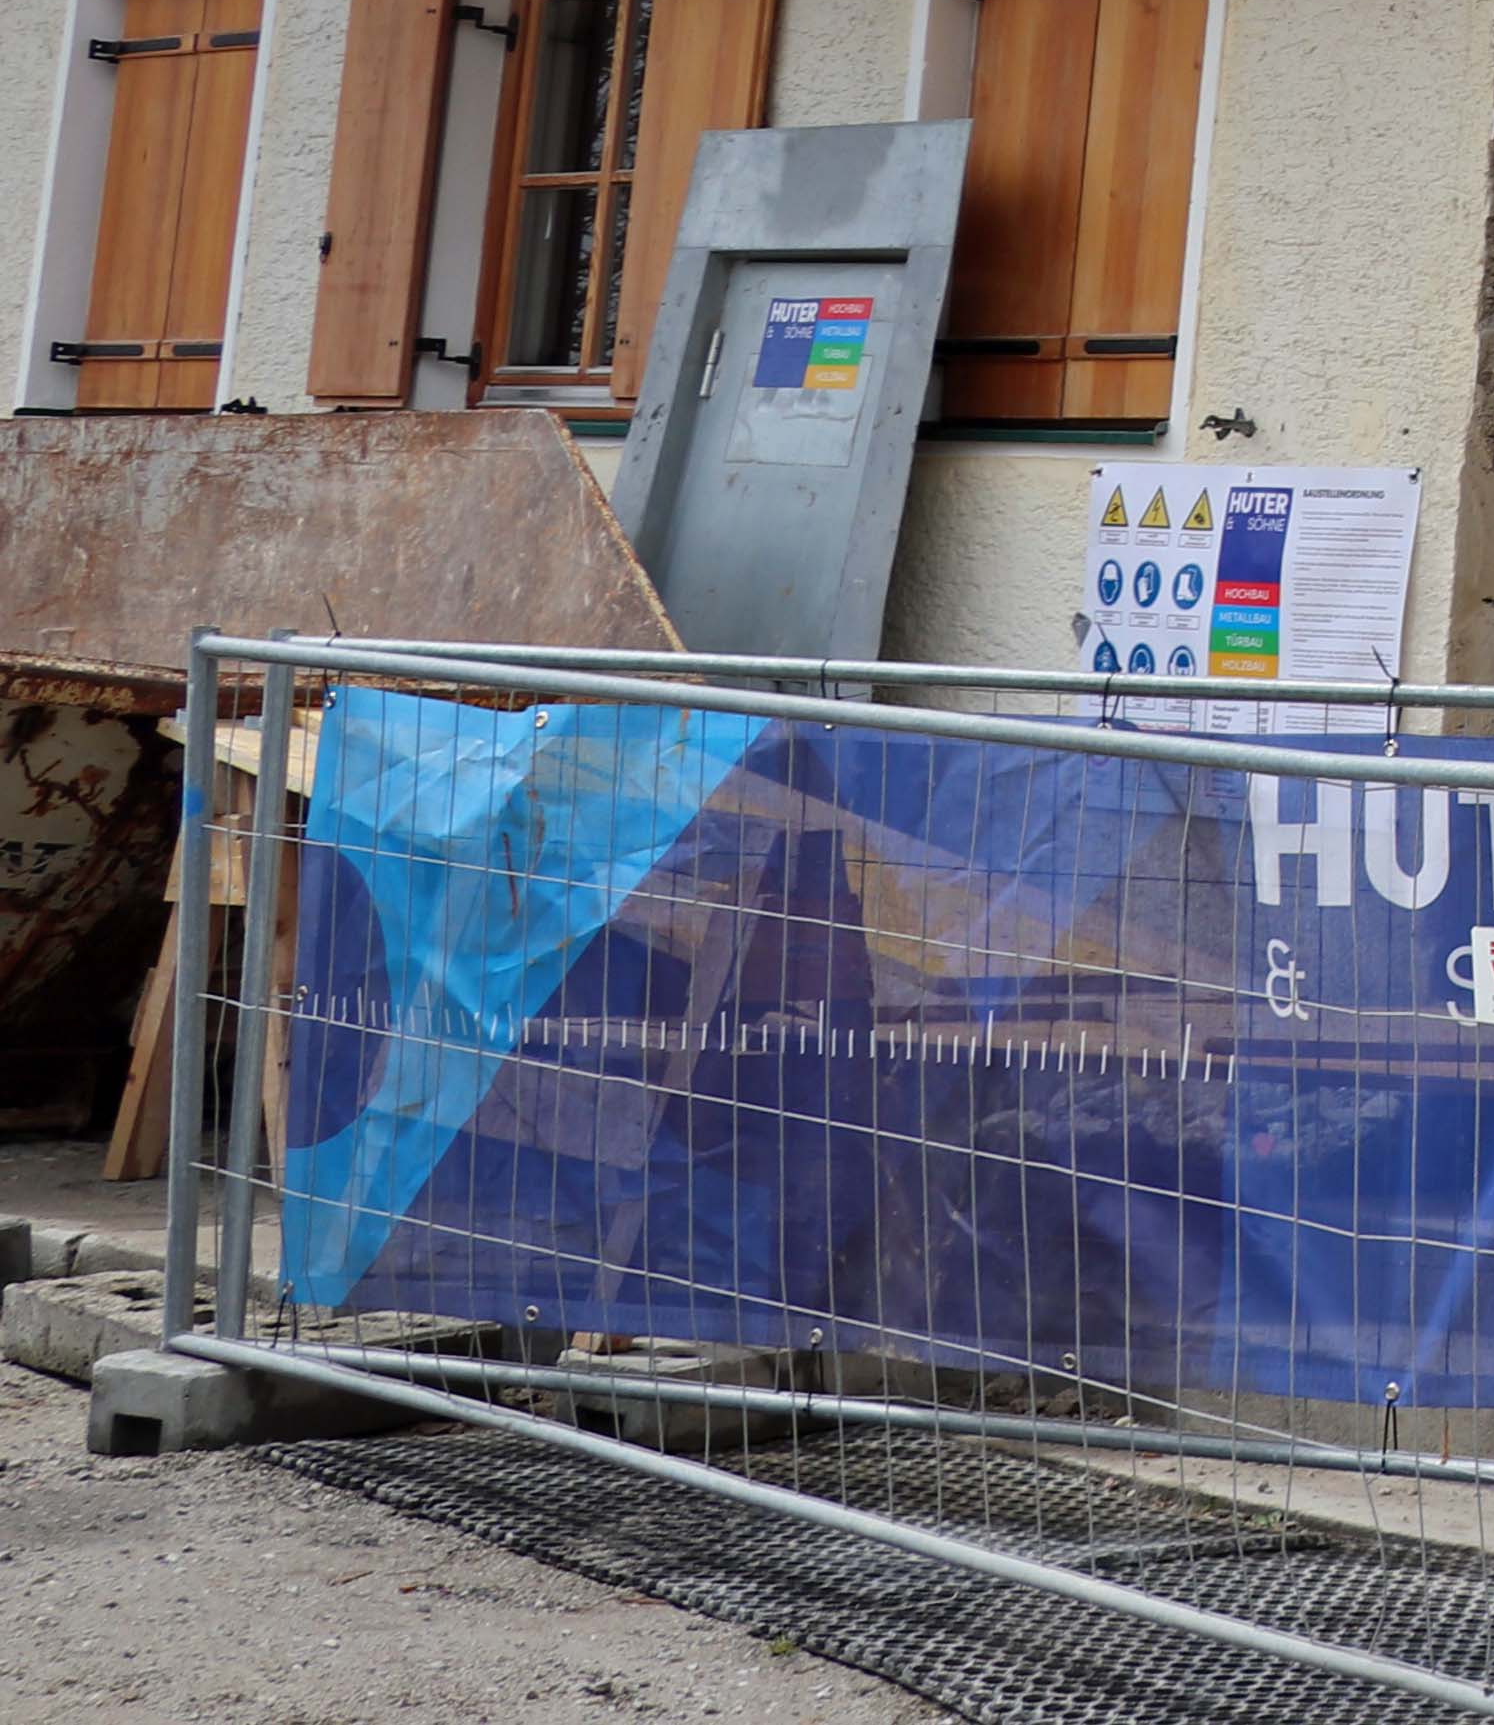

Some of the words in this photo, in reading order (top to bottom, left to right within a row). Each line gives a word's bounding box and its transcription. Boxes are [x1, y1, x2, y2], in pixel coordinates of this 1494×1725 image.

[769, 302, 819, 323] HUTER
[784, 323, 815, 339] SÖHNE
[1228, 491, 1289, 515] HUTER
[1247, 514, 1286, 533] SÖHNE
[1224, 587, 1269, 601] HOCHBAU
[1219, 611, 1272, 625] METALLBAU
[1225, 632, 1263, 649] TÜRBAU
[1221, 658, 1266, 673] HOLZBAU
[1266, 938, 1310, 1022] &
